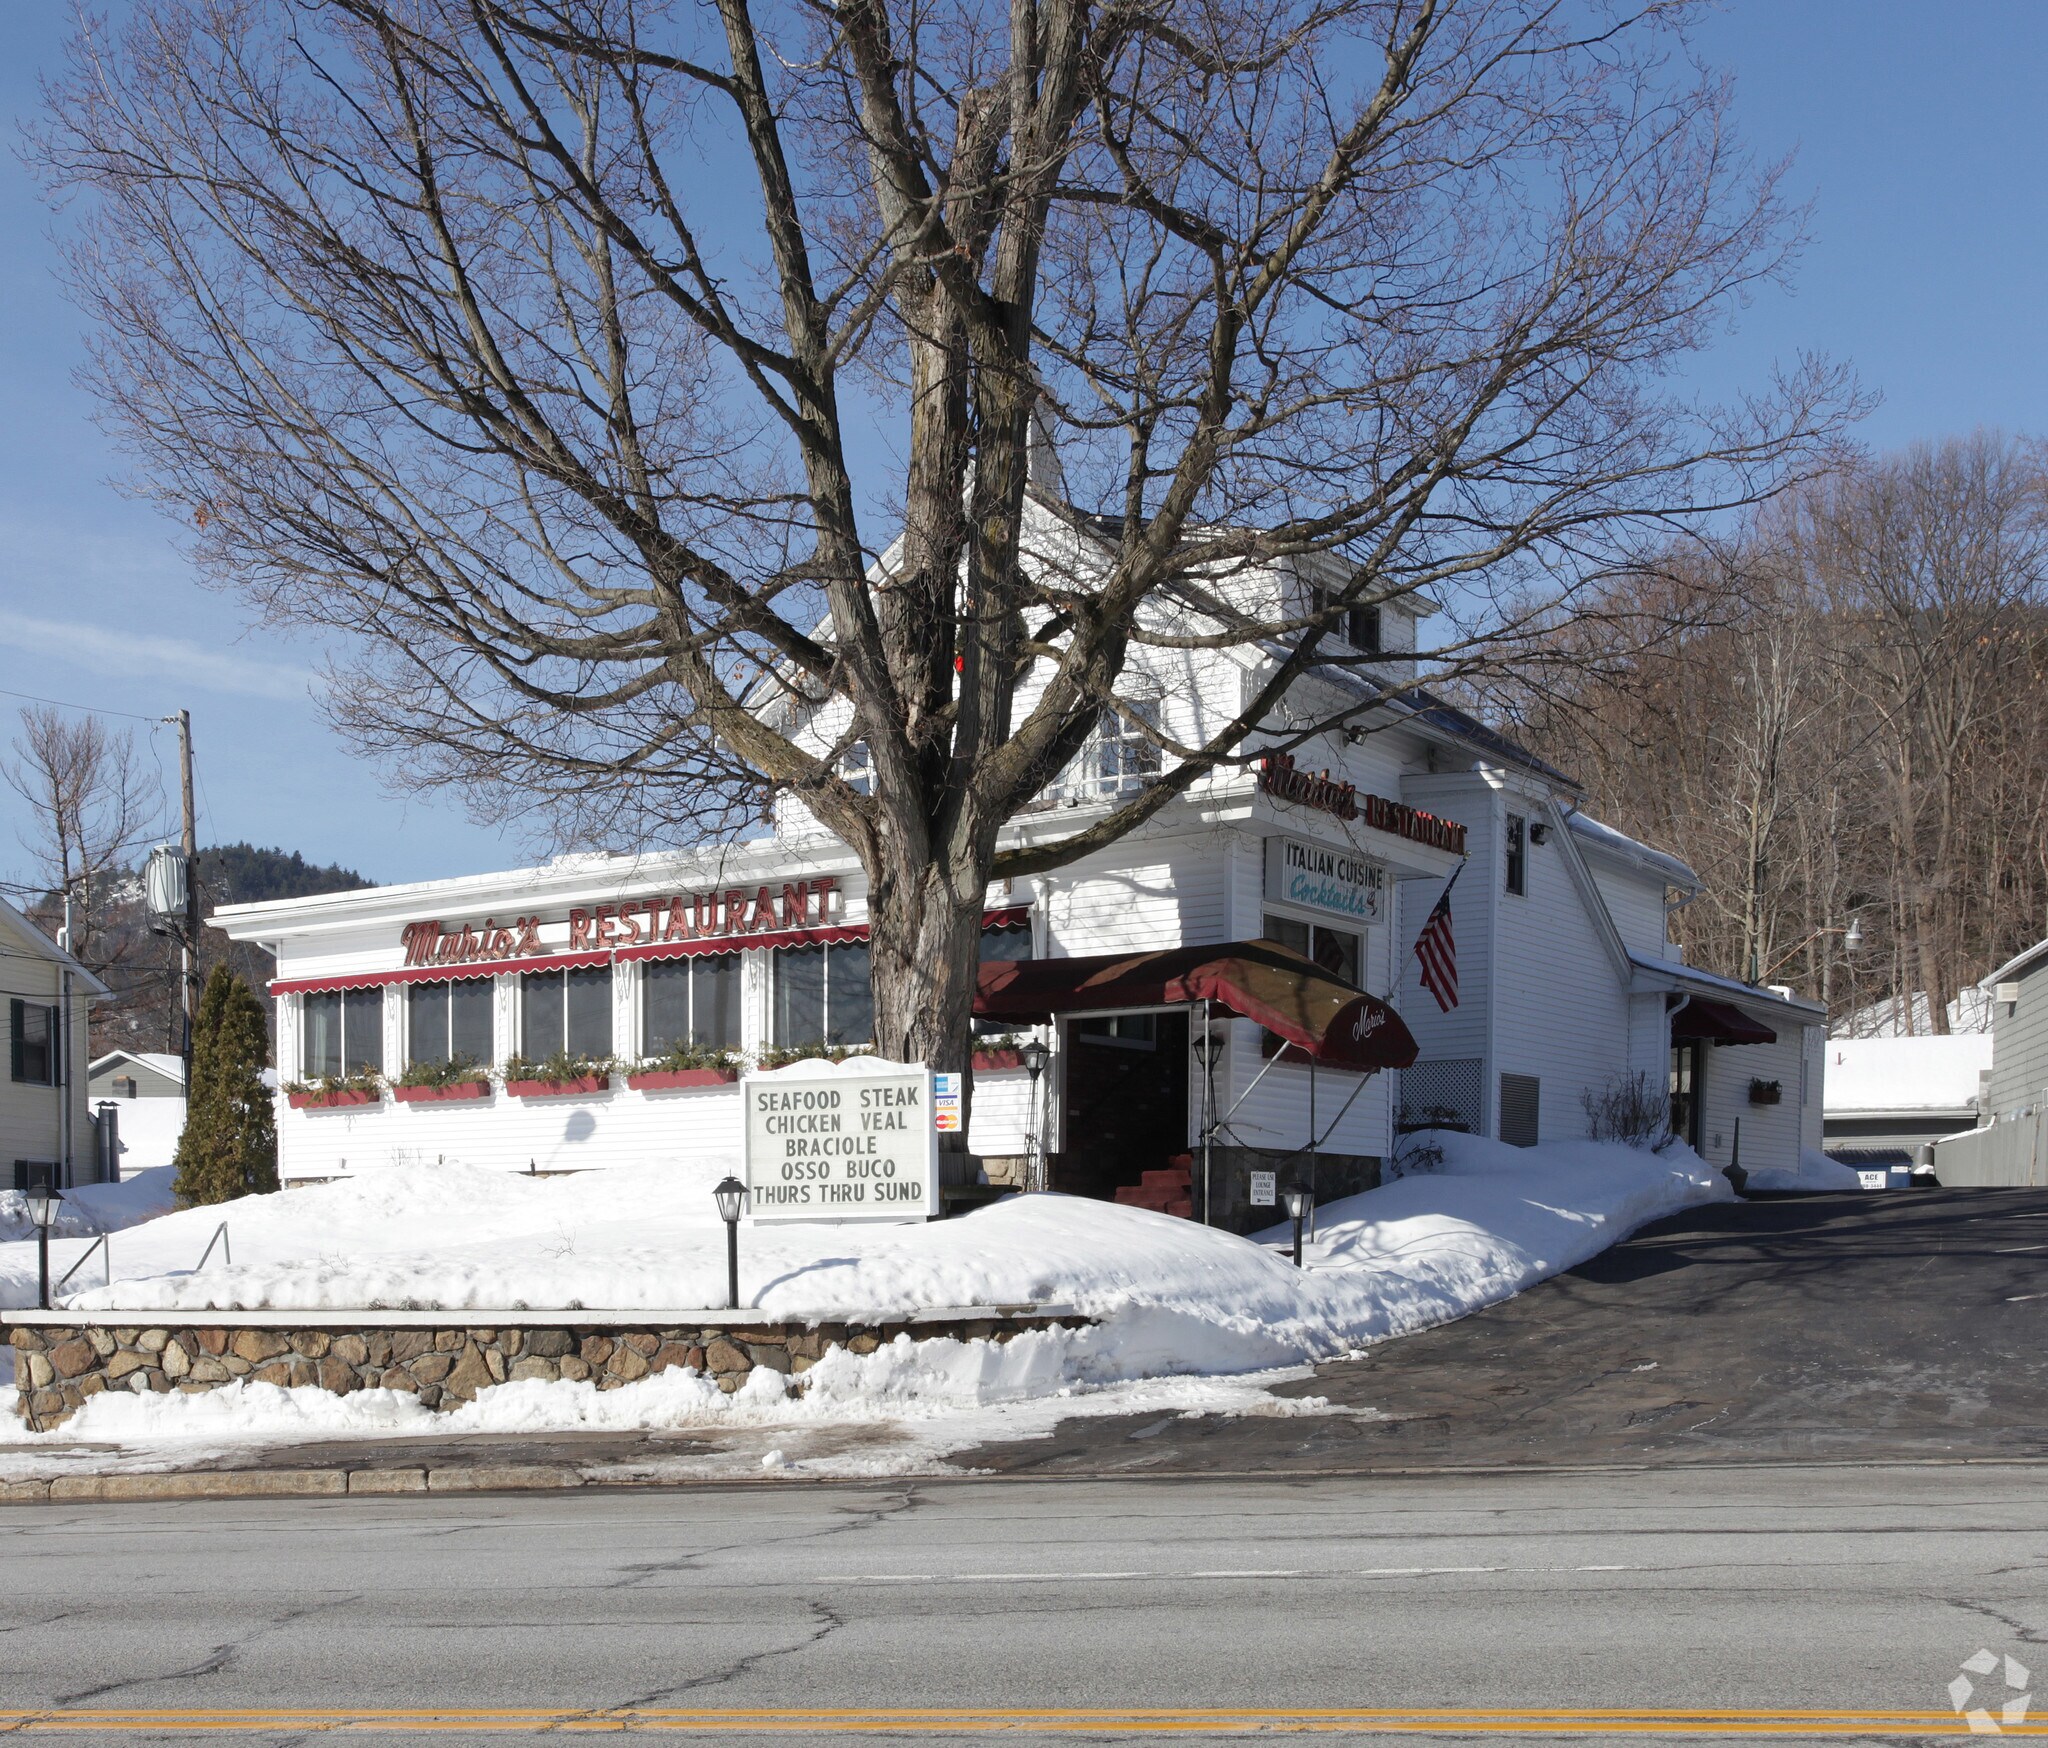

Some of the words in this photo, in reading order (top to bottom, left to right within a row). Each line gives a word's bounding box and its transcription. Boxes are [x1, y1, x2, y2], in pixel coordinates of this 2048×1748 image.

[1366, 794, 1468, 856] RESTAURANT
[1286, 843, 1334, 877] ITALIAN
[1338, 859, 1383, 890] CUISINE
[1290, 874, 1365, 914] Cocktails
[400, 919, 541, 967] Mario's
[569, 877, 834, 951] RESTAURANT
[1352, 1005, 1386, 1041] Mario's
[758, 1090, 841, 1112] SEAFOOD
[859, 1086, 918, 1108] STEAK
[765, 1114, 841, 1134] CHICKEN
[860, 1111, 908, 1131] VEAL
[786, 1136, 877, 1157] BRACIOLE
[781, 1161, 830, 1180] OSSO
[846, 1159, 896, 1179] BUCO
[1252, 1173, 1267, 1181] PLEASE
[1864, 1173, 1878, 1181] ACE
[753, 1185, 811, 1204] THURS
[818, 1184, 865, 1203] THRU
[874, 1182, 922, 1201] SUND
[1253, 1189, 1274, 1197] ENTRANCE
[1255, 1181, 1271, 1189] LOUNGE
